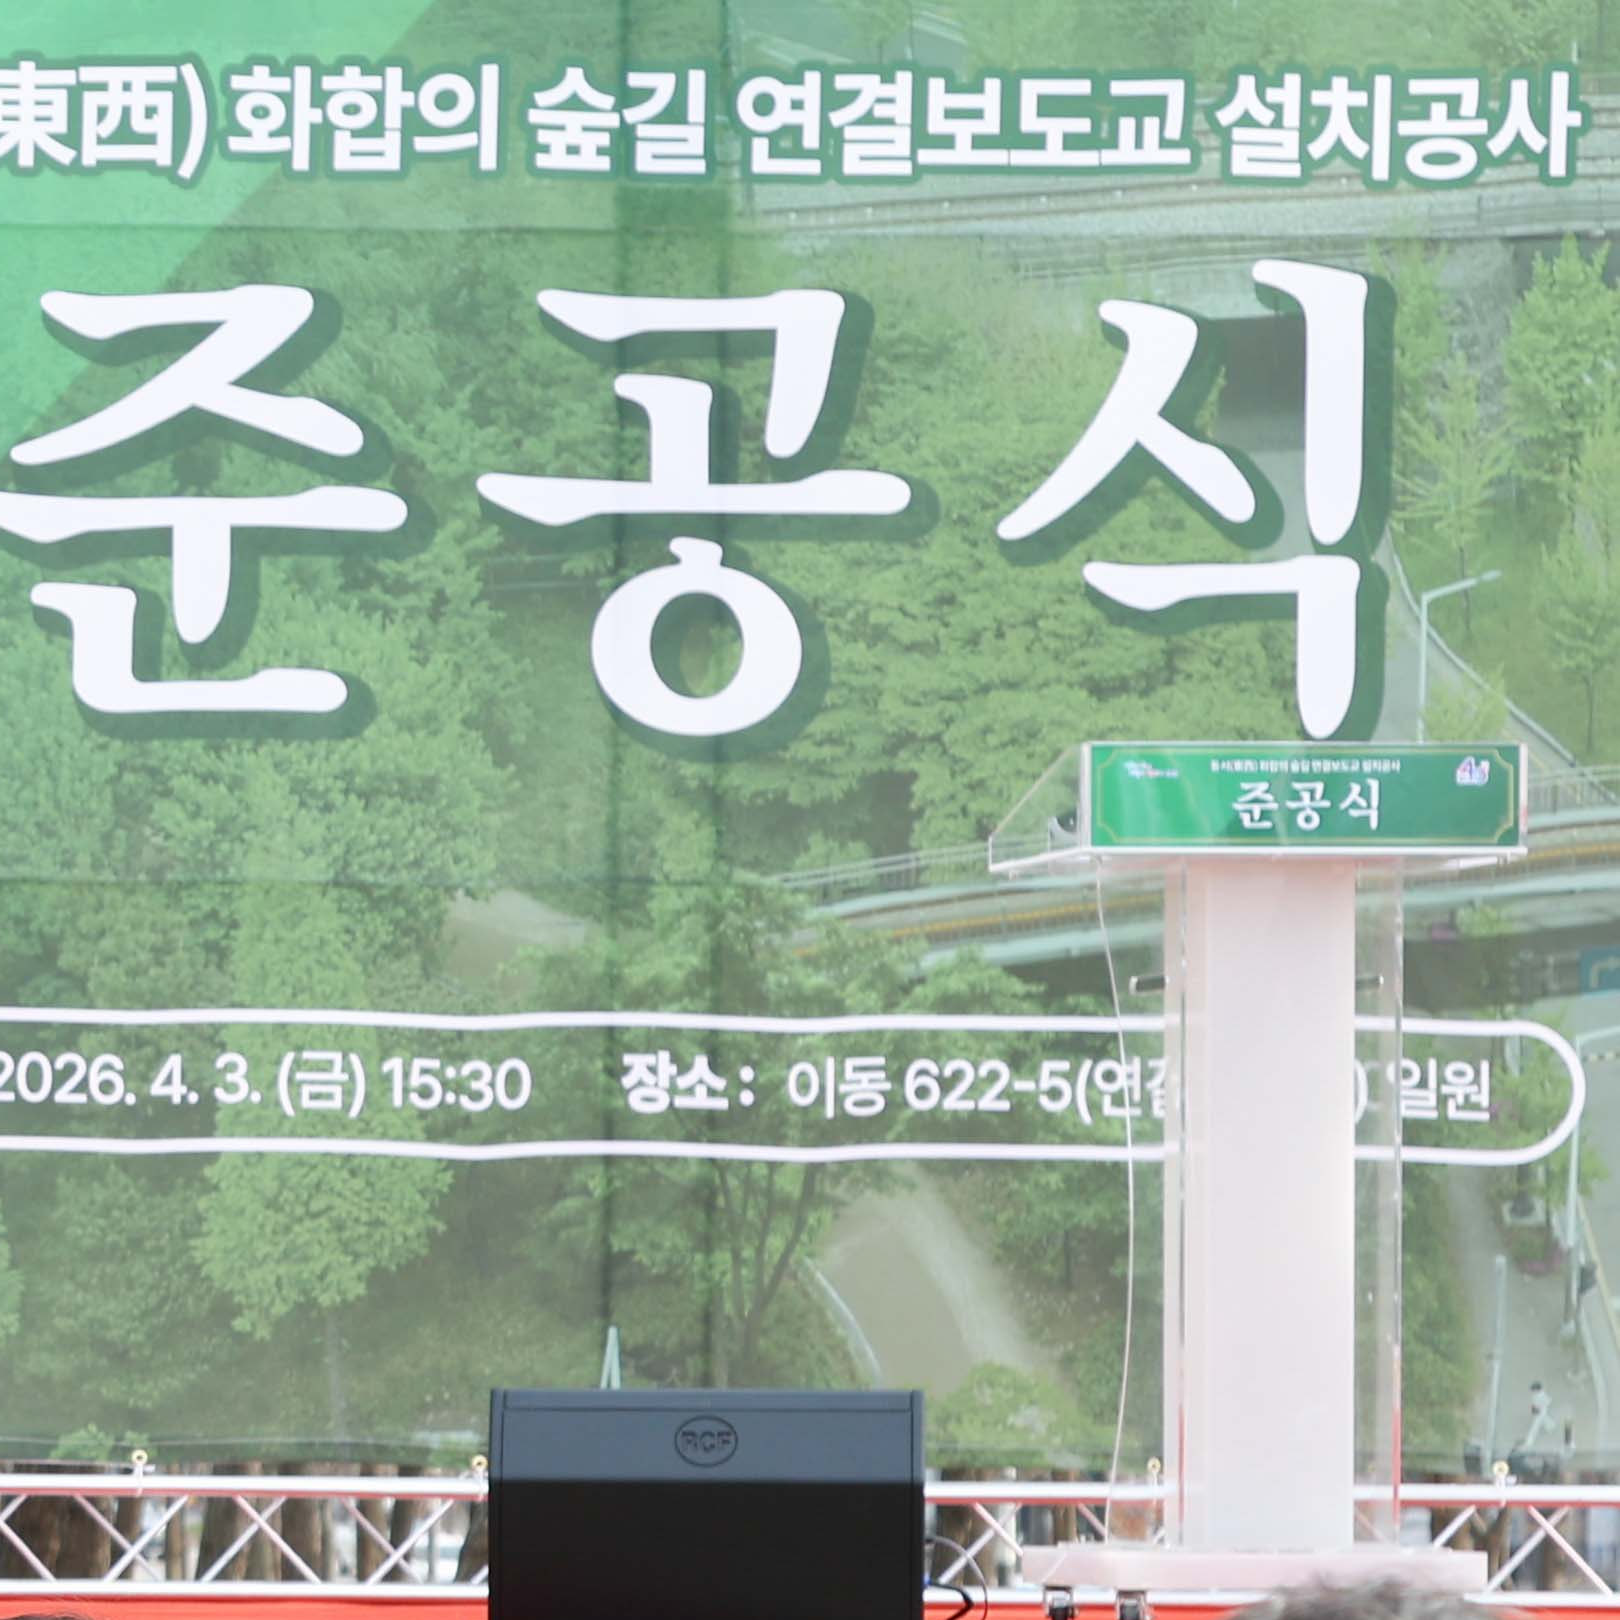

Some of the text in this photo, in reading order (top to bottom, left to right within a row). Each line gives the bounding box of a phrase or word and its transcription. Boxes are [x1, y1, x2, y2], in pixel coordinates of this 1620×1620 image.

[228, 64, 499, 171] 화합의
[528, 67, 706, 173] 숲길
[737, 71, 1191, 175] 연결보도교
[1216, 71, 1582, 180] 설치공사
[1233, 779, 1380, 830] 준공식
[150, 1054, 199, 1104] 4.
[214, 1052, 262, 1104] 3.
[277, 1051, 366, 1118] (금)
[382, 1057, 532, 1111] 15:30
[788, 1056, 892, 1118] 이동
[1386, 1058, 1491, 1121] 일원
